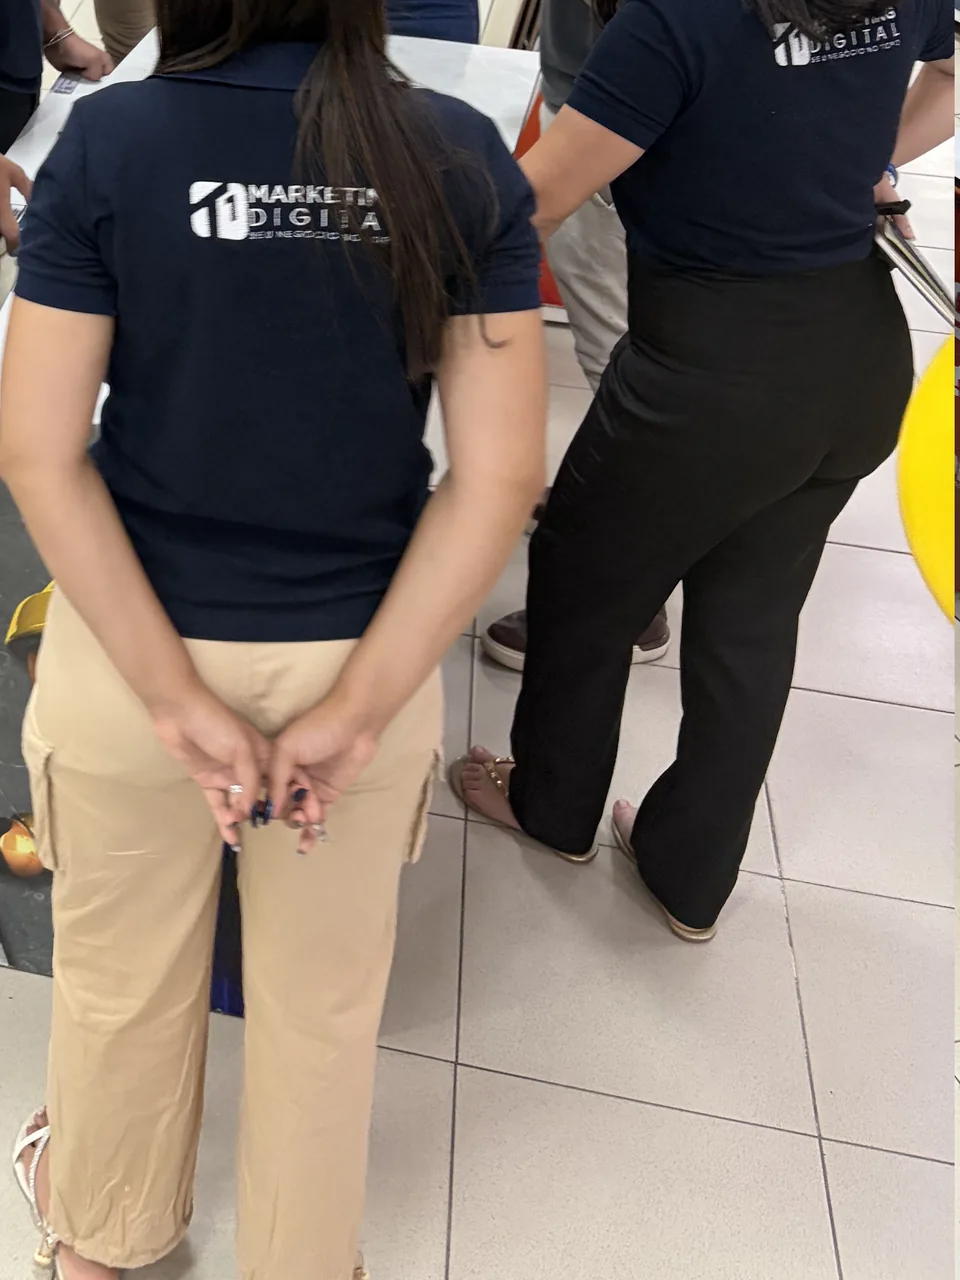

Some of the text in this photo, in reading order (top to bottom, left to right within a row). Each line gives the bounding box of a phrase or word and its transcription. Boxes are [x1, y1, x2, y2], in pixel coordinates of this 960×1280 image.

[809, 22, 901, 53] DIGITAL
[248, 184, 379, 207] MARKETIN
[248, 207, 382, 231] DIGITA
